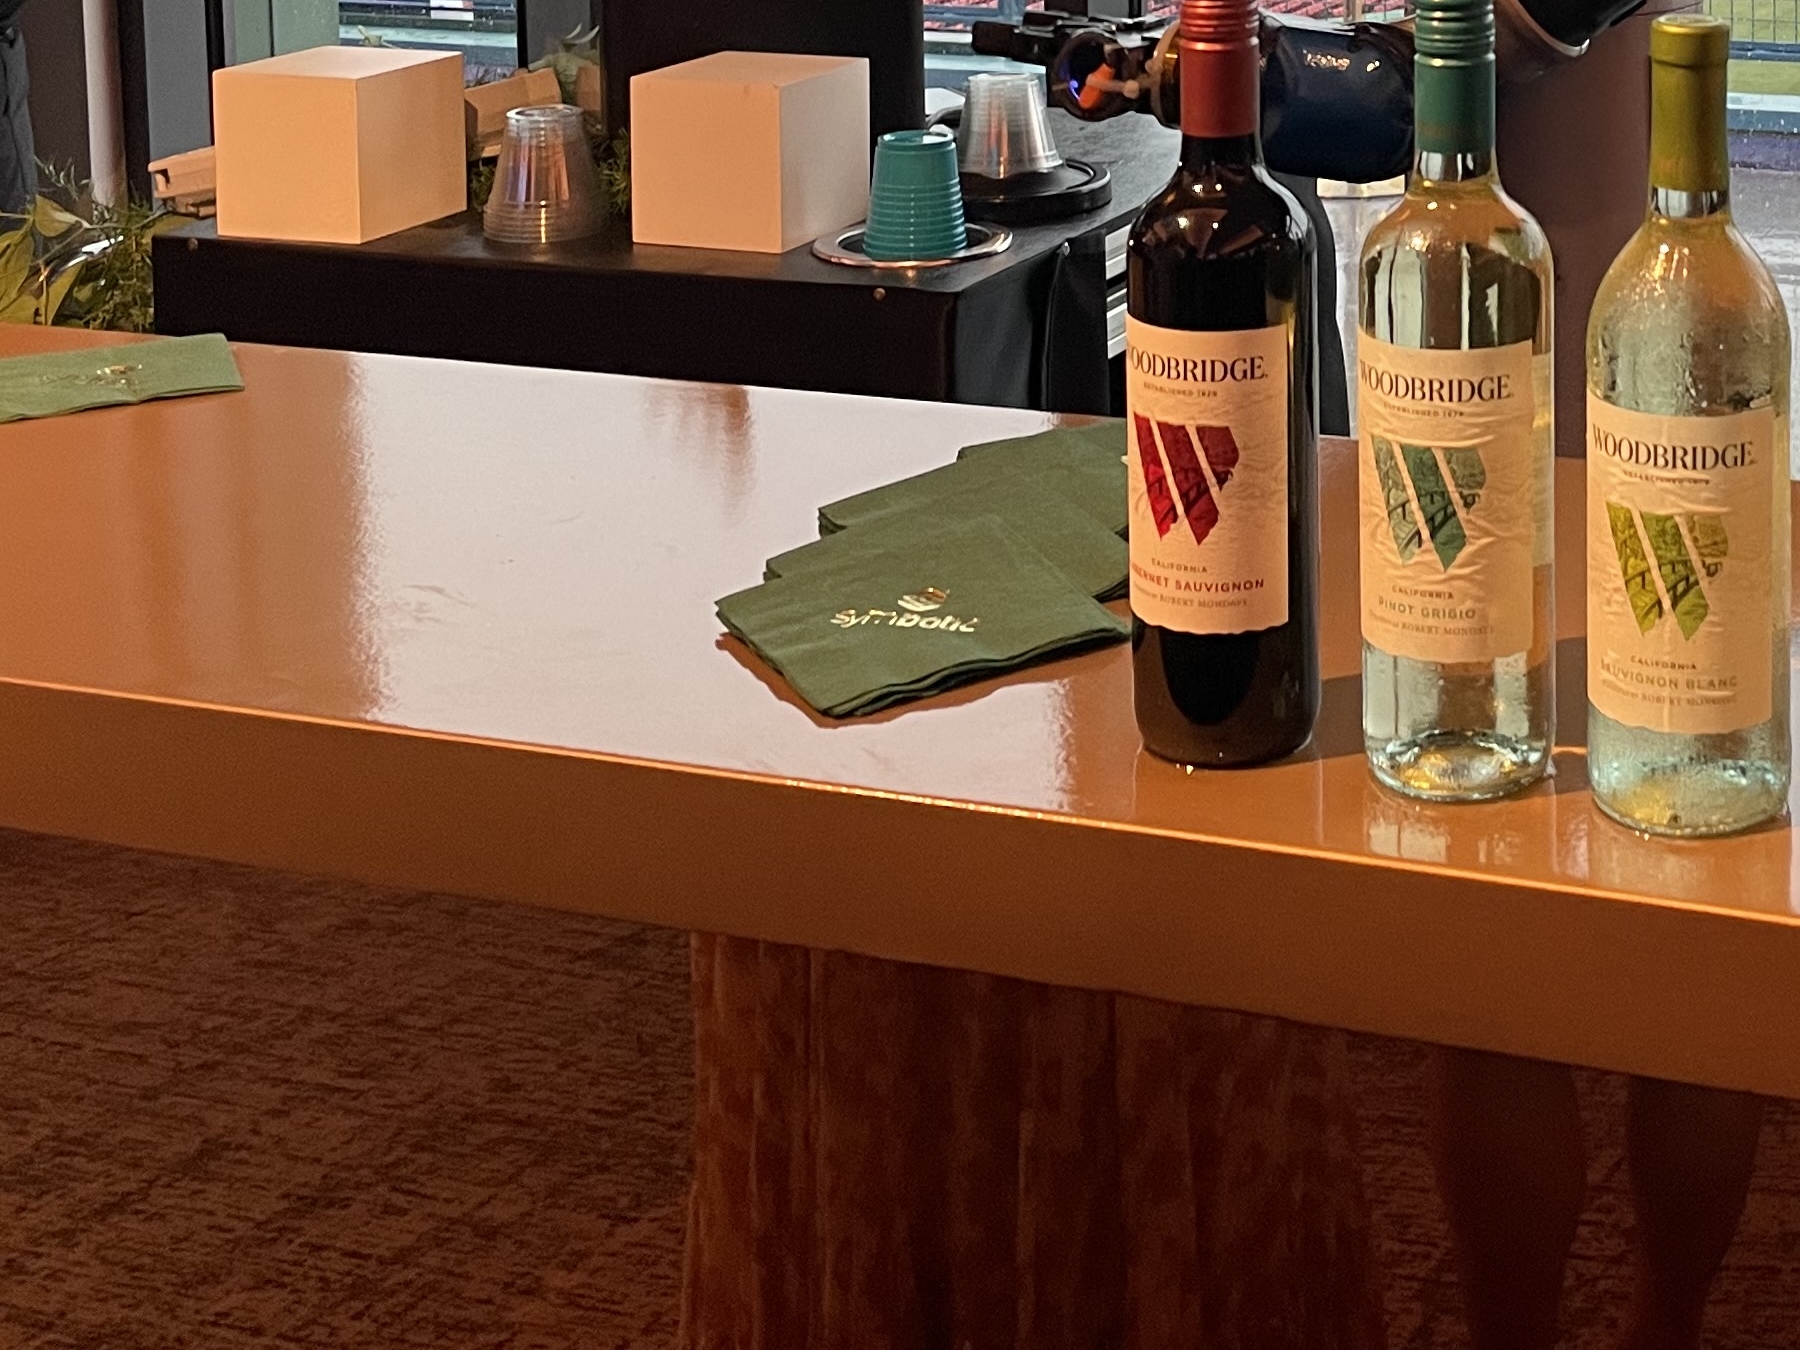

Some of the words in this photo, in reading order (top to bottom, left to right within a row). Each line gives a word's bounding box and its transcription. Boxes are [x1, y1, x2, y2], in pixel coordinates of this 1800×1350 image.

[1130, 345, 1266, 383] OODBRIDGE
[1360, 359, 1512, 403] WOODBRIDGE
[1592, 423, 1755, 470] WOODBRIDGE
[1151, 557, 1208, 573] CALIFORNIA
[1175, 578, 1265, 594] SAUVIGNON
[1391, 584, 1455, 600] CALIFORNIA
[1377, 595, 1415, 615] PINOT
[1421, 607, 1477, 620] GRIGIO
[1630, 654, 1697, 670] CALIFORNIA
[1685, 675, 1738, 691] BLANC
